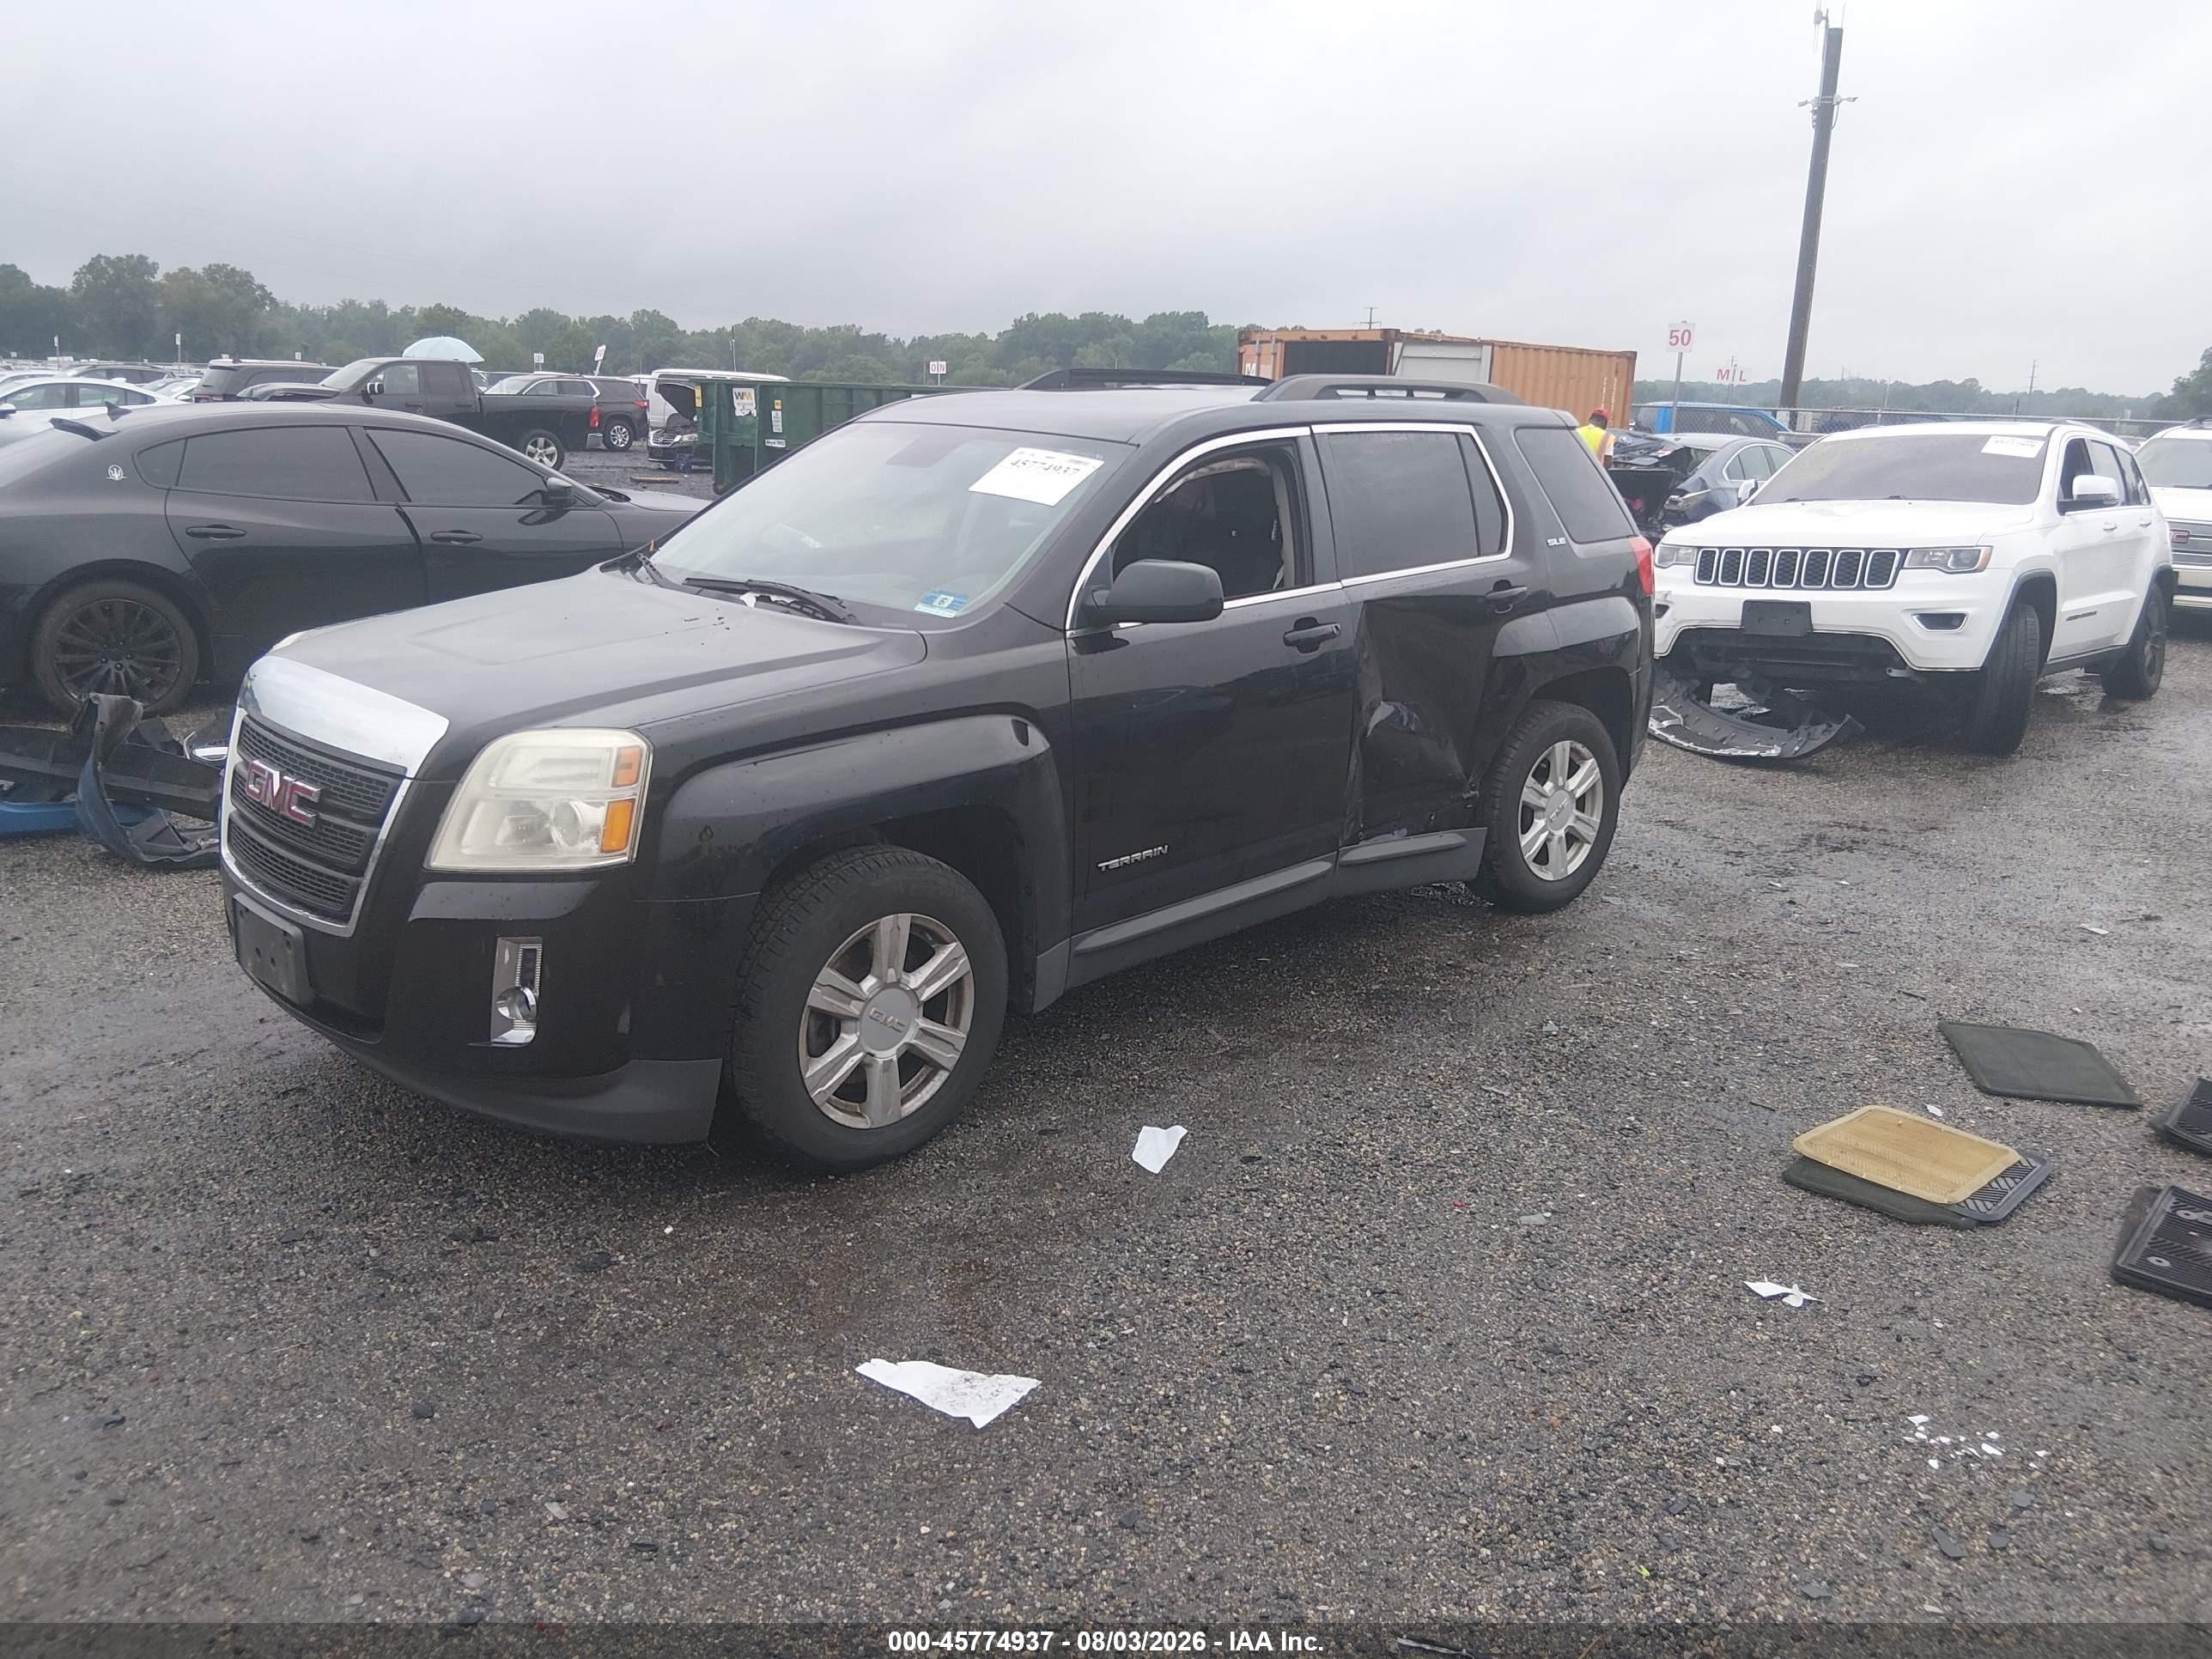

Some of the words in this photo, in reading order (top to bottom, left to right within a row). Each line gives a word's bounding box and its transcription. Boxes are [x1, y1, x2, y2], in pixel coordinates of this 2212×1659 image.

[1668, 329, 1692, 346] 50
[734, 392, 753, 400] WM
[246, 759, 321, 828] GMC
[1097, 844, 1169, 872] TERRAIN
